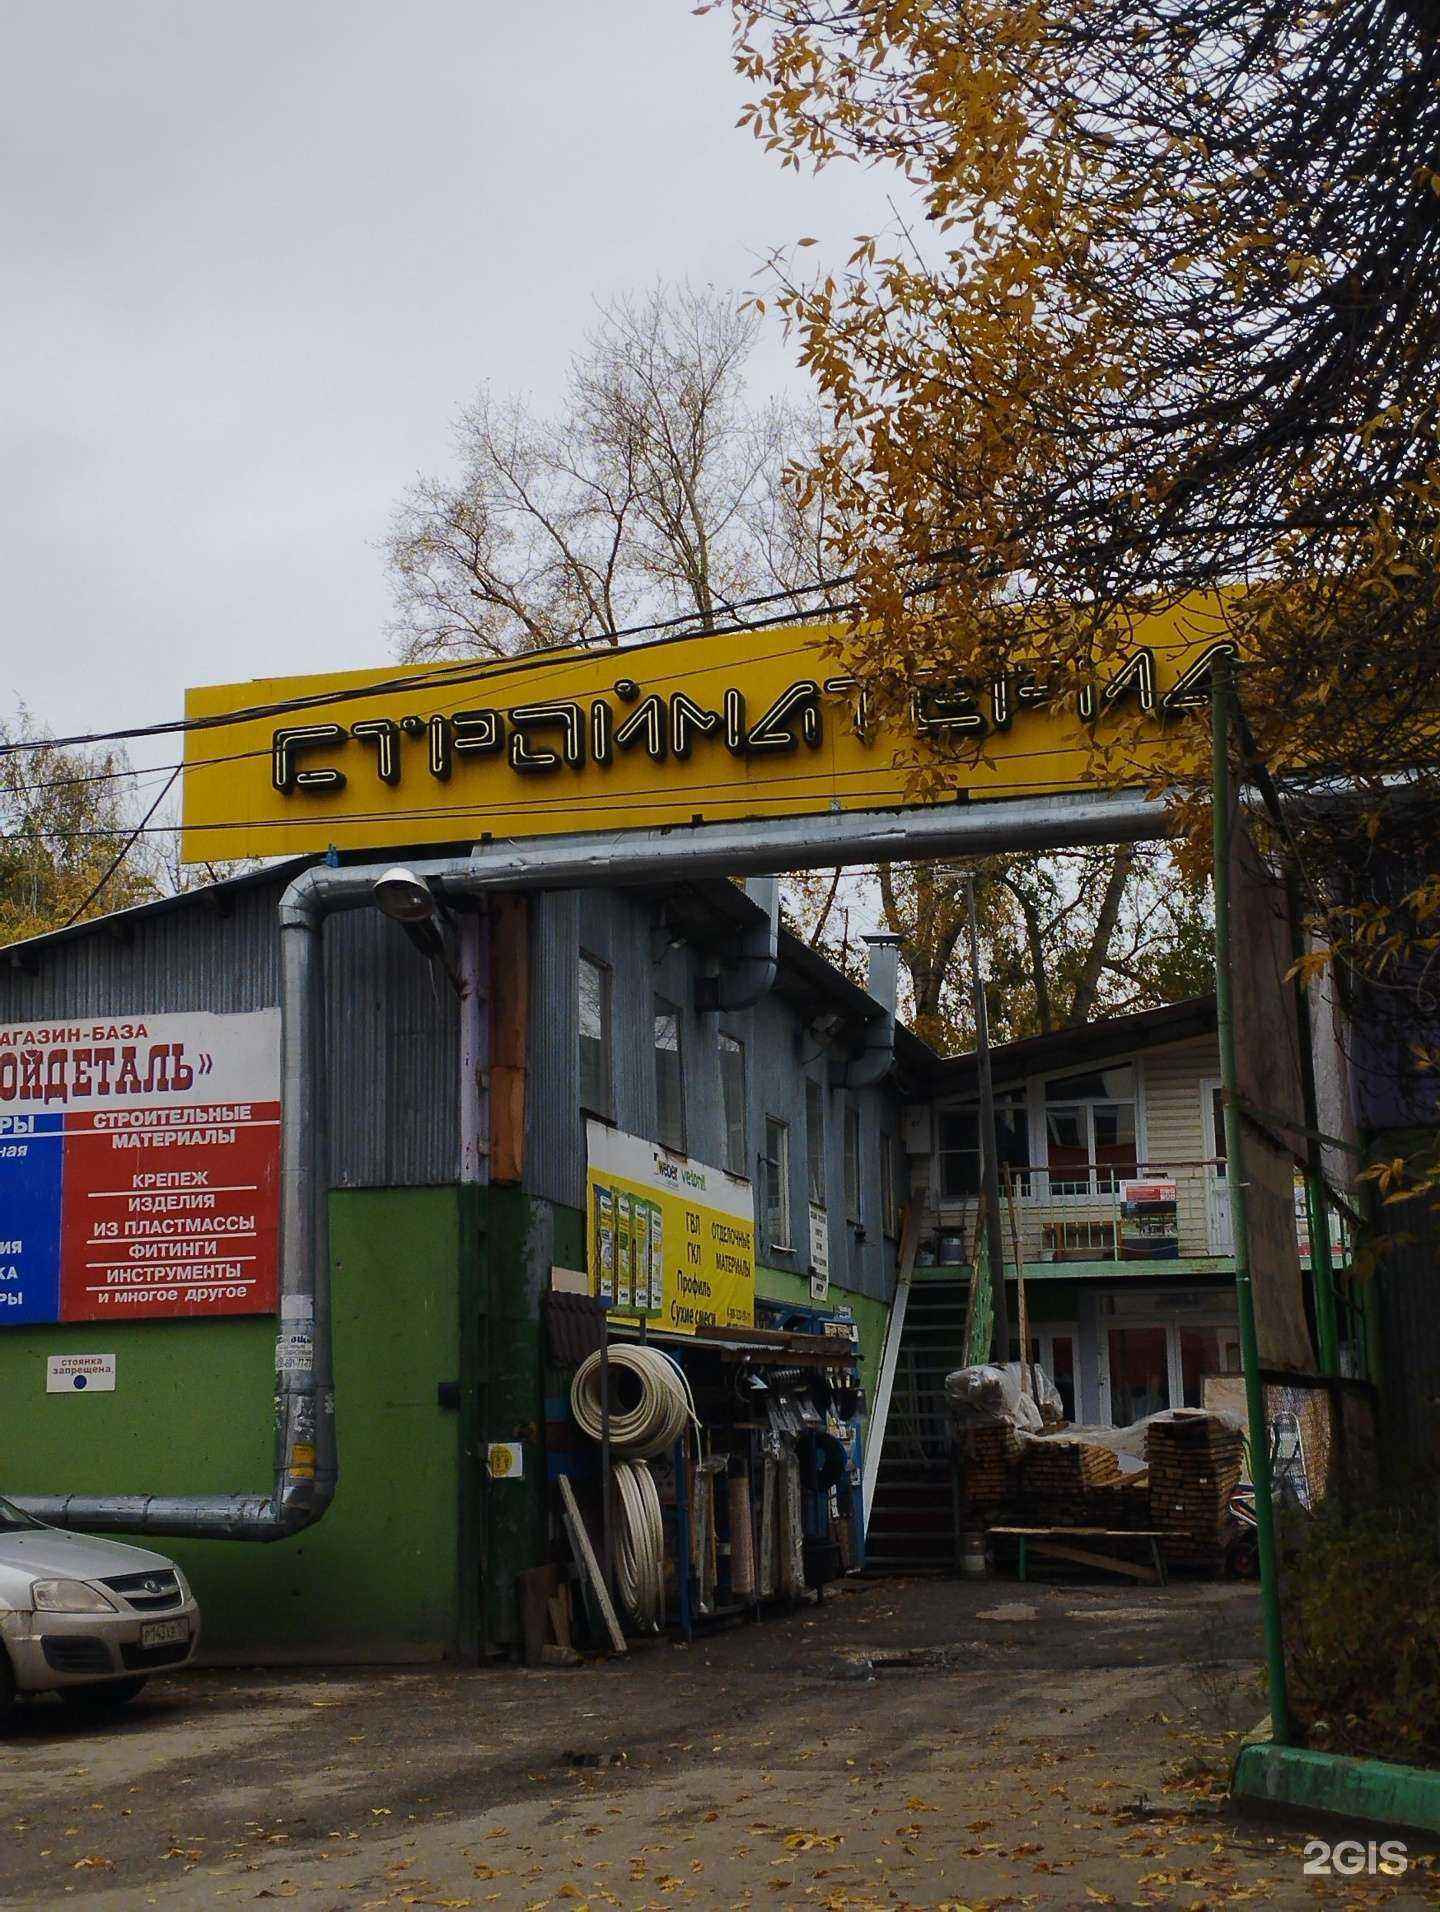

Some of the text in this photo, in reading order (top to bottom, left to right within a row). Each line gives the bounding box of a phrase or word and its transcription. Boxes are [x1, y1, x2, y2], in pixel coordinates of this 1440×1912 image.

[93, 1104, 251, 1129] СТРОИТЕЛЬНЫЕ
[112, 1128, 236, 1150] МАТЕРИАЛЫ
[132, 1171, 209, 1189] КРЕПЕЖ
[128, 1194, 216, 1213] ИЗДЕЛИЯ
[93, 1215, 255, 1237] ИЗ ПЛАСТМАССЫ
[128, 1240, 217, 1259] ФИТИНГИ
[107, 1263, 242, 1284] ИНСТРУМЕНТЫ
[715, 1252, 751, 1278] МАТЕРИАЛЫ
[98, 1285, 248, 1304] и многое другое
[676, 1269, 712, 1300] Профиль
[52, 1367, 112, 1376] запрещена
[61, 1358, 103, 1367] стоянка
